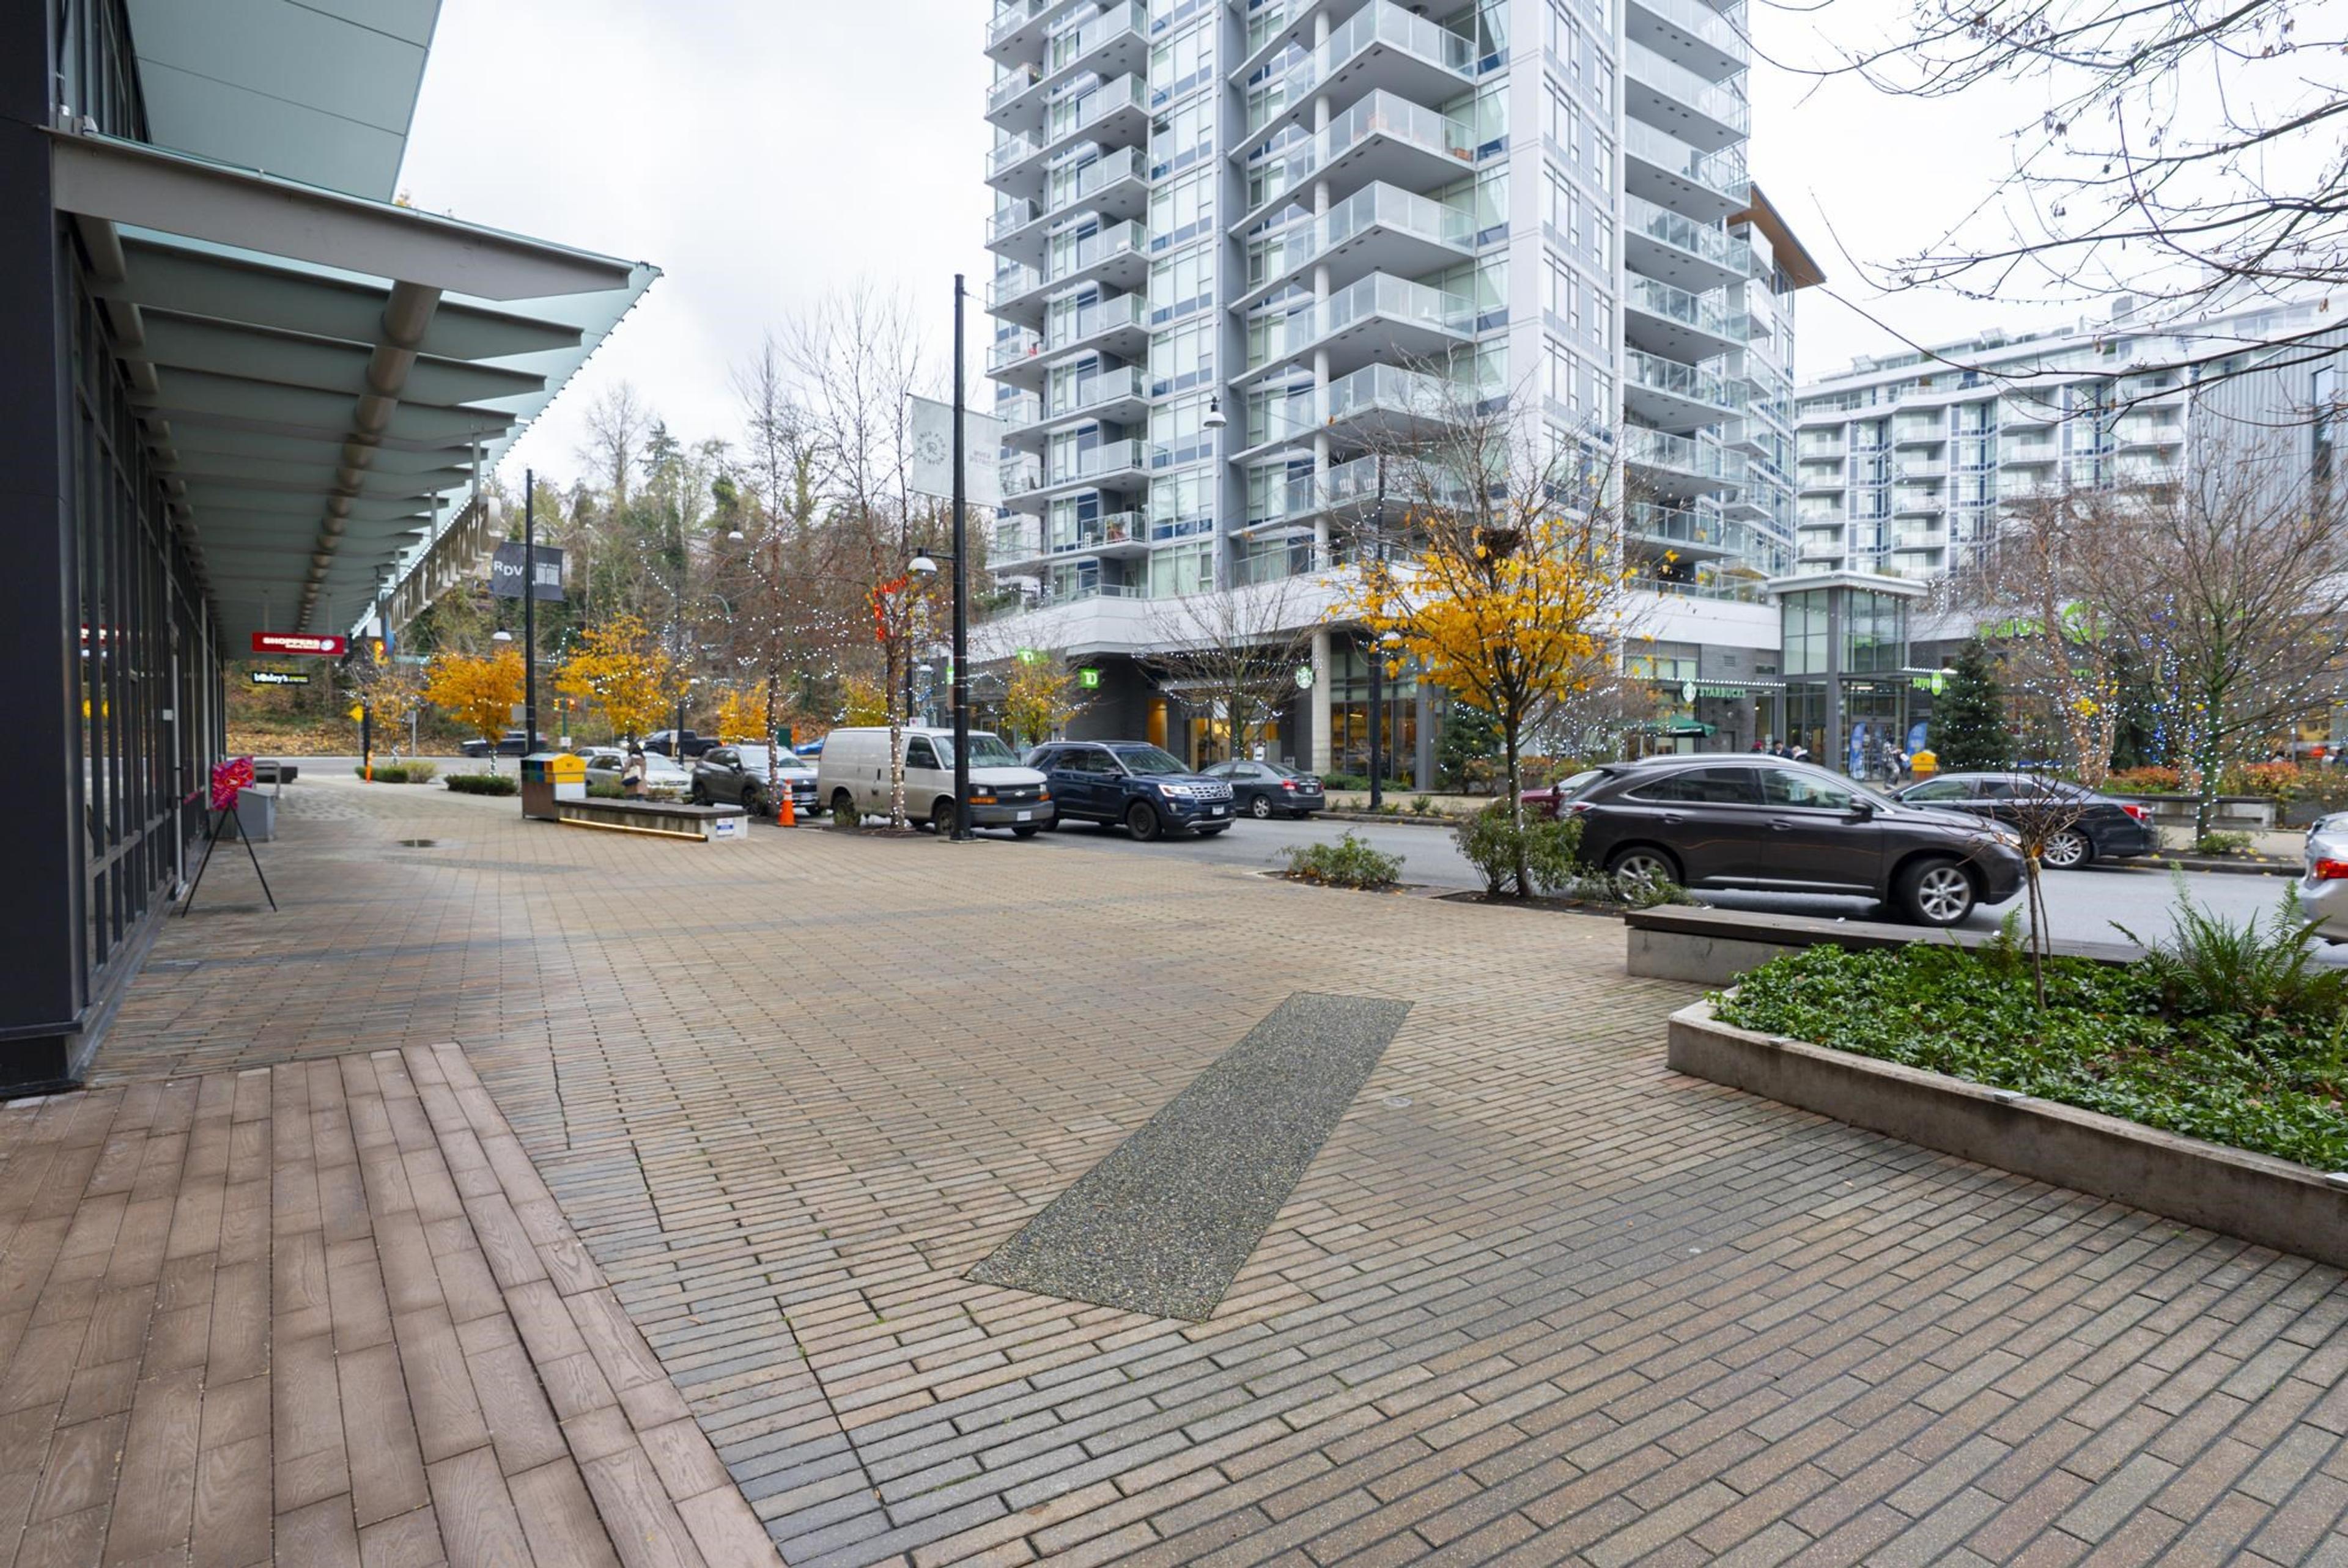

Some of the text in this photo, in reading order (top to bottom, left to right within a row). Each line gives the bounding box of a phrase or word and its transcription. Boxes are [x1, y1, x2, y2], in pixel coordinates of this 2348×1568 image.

[493, 561, 523, 576] RDV
[1084, 672, 1098, 685] TD
[1699, 687, 1746, 698] STARBUCKS
